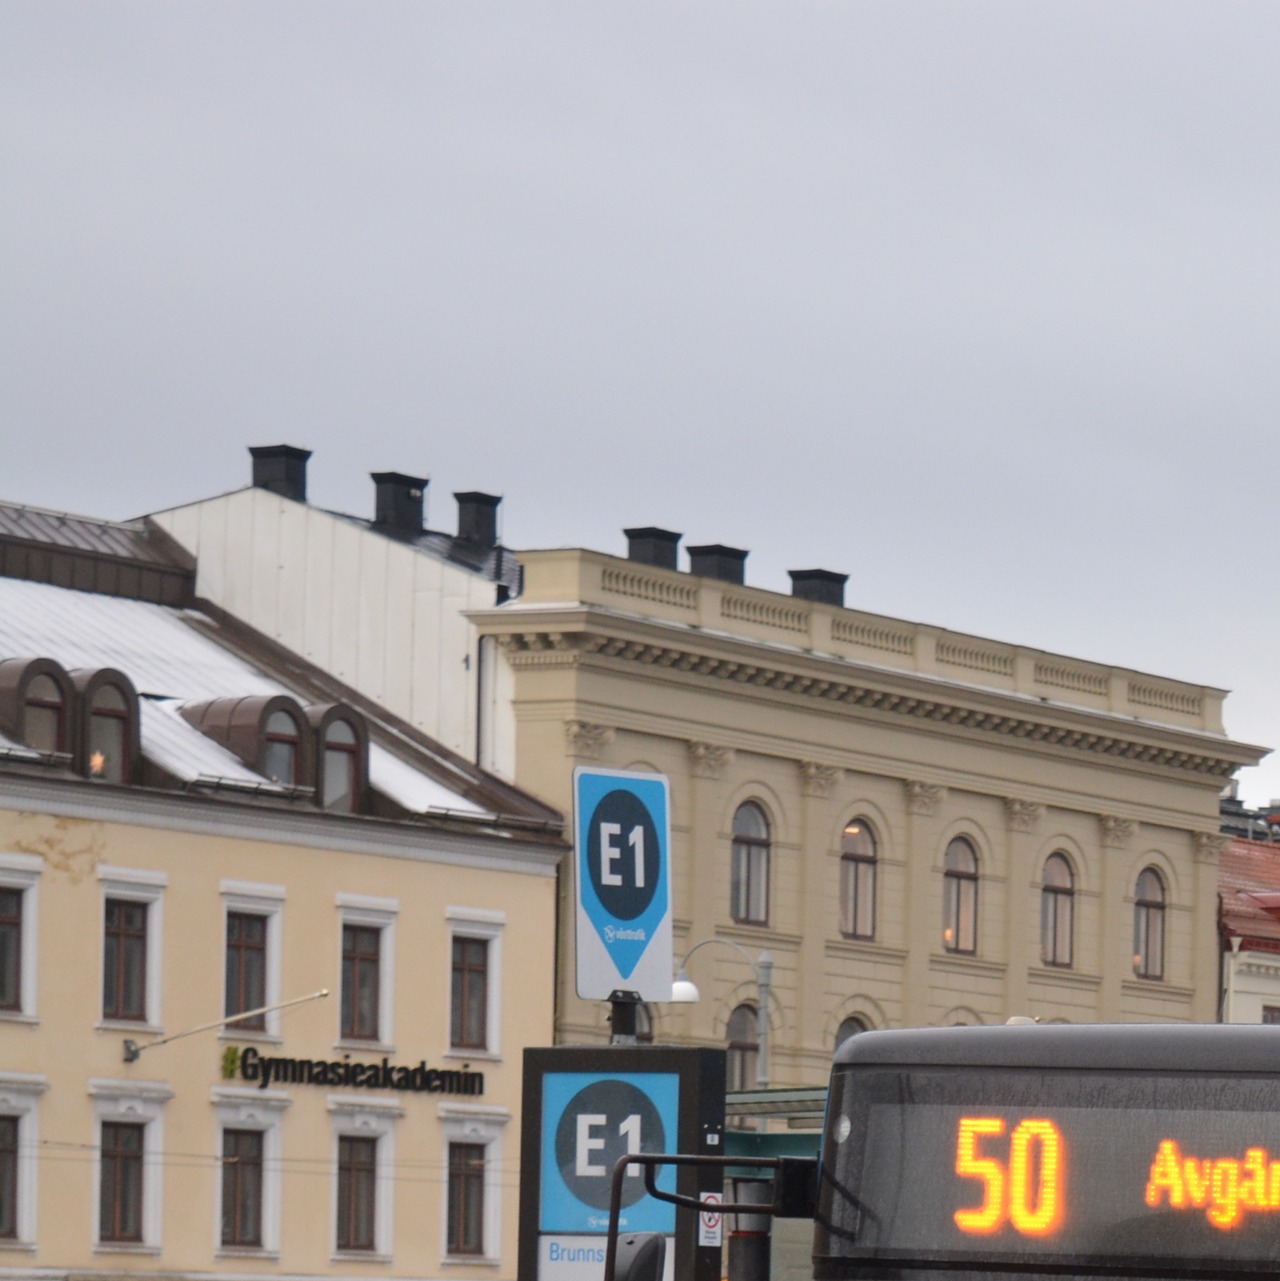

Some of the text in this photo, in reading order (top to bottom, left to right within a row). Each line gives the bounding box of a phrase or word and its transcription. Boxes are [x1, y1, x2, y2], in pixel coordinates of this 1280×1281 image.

[600, 821, 646, 889] E1
[221, 1045, 485, 1097] #Gymnasieakademin
[575, 1113, 642, 1178] E1
[954, 1117, 1062, 1234] 50
[549, 1241, 605, 1263] Brunns
